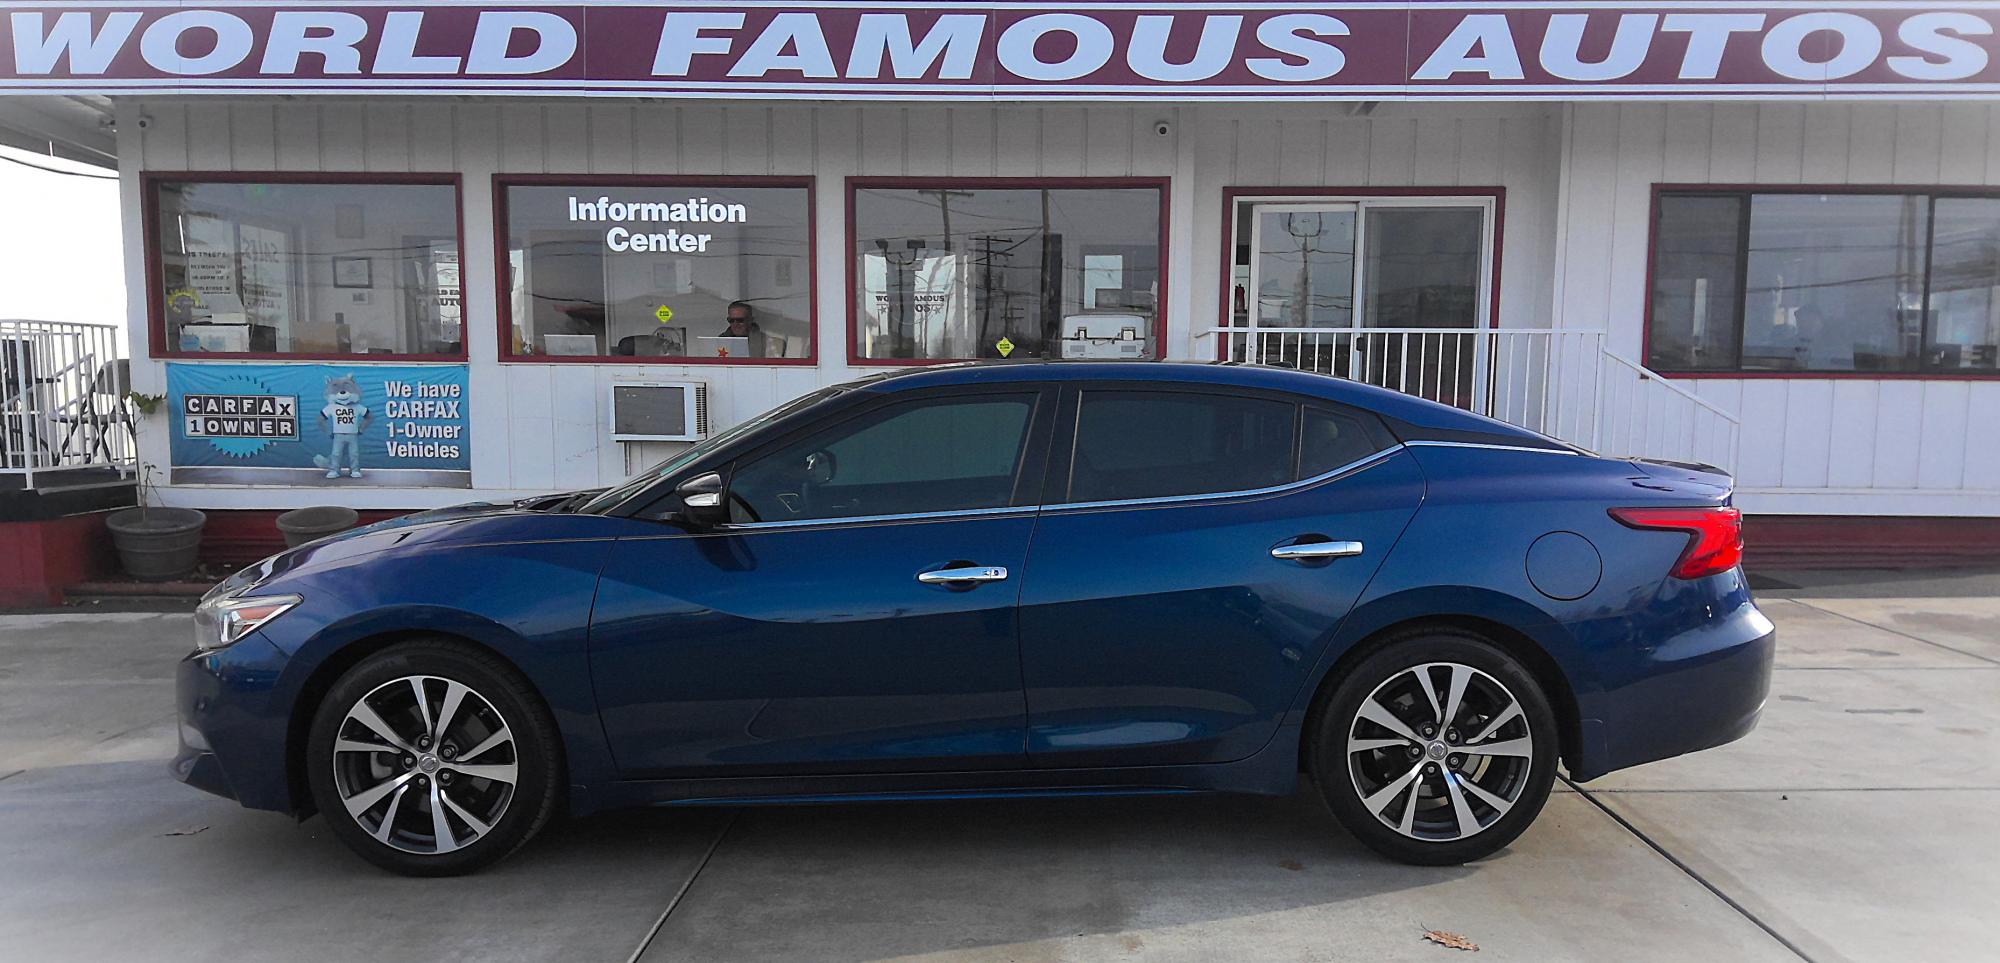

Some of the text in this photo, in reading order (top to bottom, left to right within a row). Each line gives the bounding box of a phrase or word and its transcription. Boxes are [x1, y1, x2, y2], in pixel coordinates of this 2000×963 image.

[11, 10, 1994, 82] WORLD FAMOUS AUTOS
[568, 196, 747, 223] Information
[606, 226, 712, 252] Center
[384, 380, 461, 398] We have
[187, 398, 292, 416] CARFAX
[335, 408, 355, 417] CAR
[385, 400, 461, 419] CARFAX
[336, 416, 355, 425] FOX
[386, 421, 462, 438] 1-Owner
[386, 441, 461, 458] Vehicles
